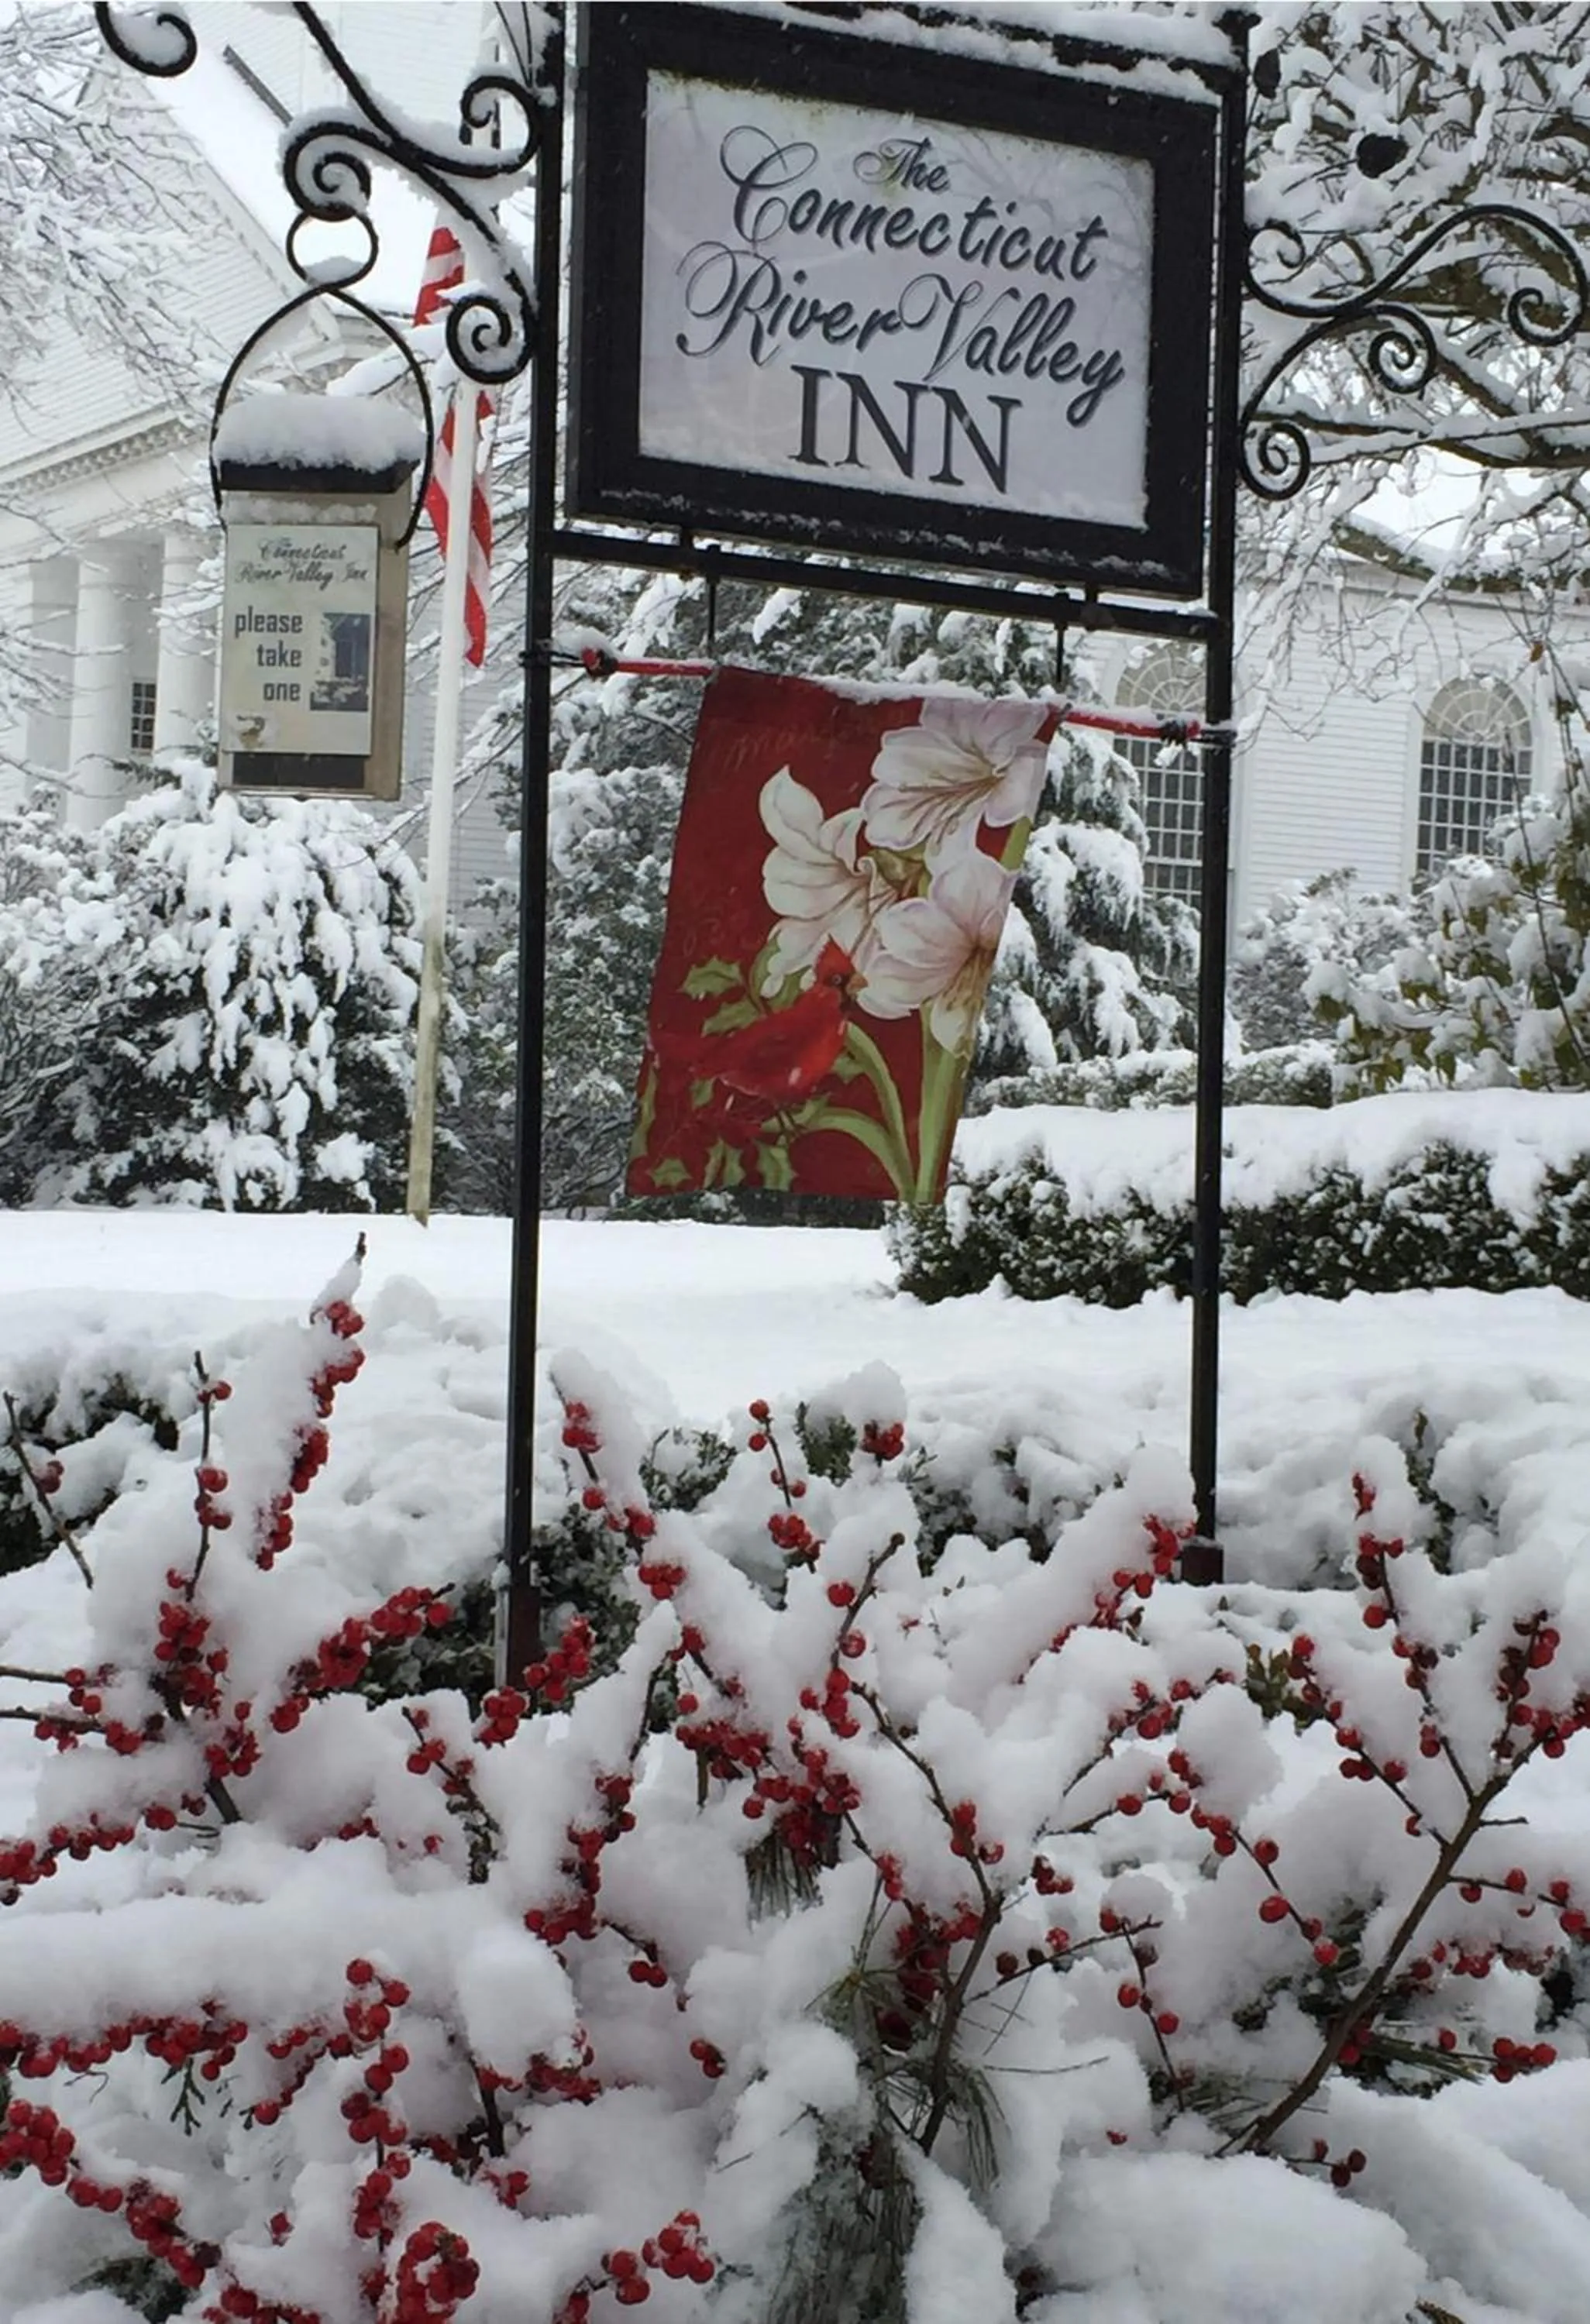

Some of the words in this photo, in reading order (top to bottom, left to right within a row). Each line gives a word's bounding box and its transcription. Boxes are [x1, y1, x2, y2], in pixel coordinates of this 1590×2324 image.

[854, 138, 950, 193] The
[720, 125, 1109, 281] Connecticut
[676, 241, 902, 366] River
[898, 273, 1126, 428] Valley
[789, 364, 1023, 494] INN
[235, 606, 303, 638] please
[256, 640, 302, 668] take
[263, 682, 301, 701] one
